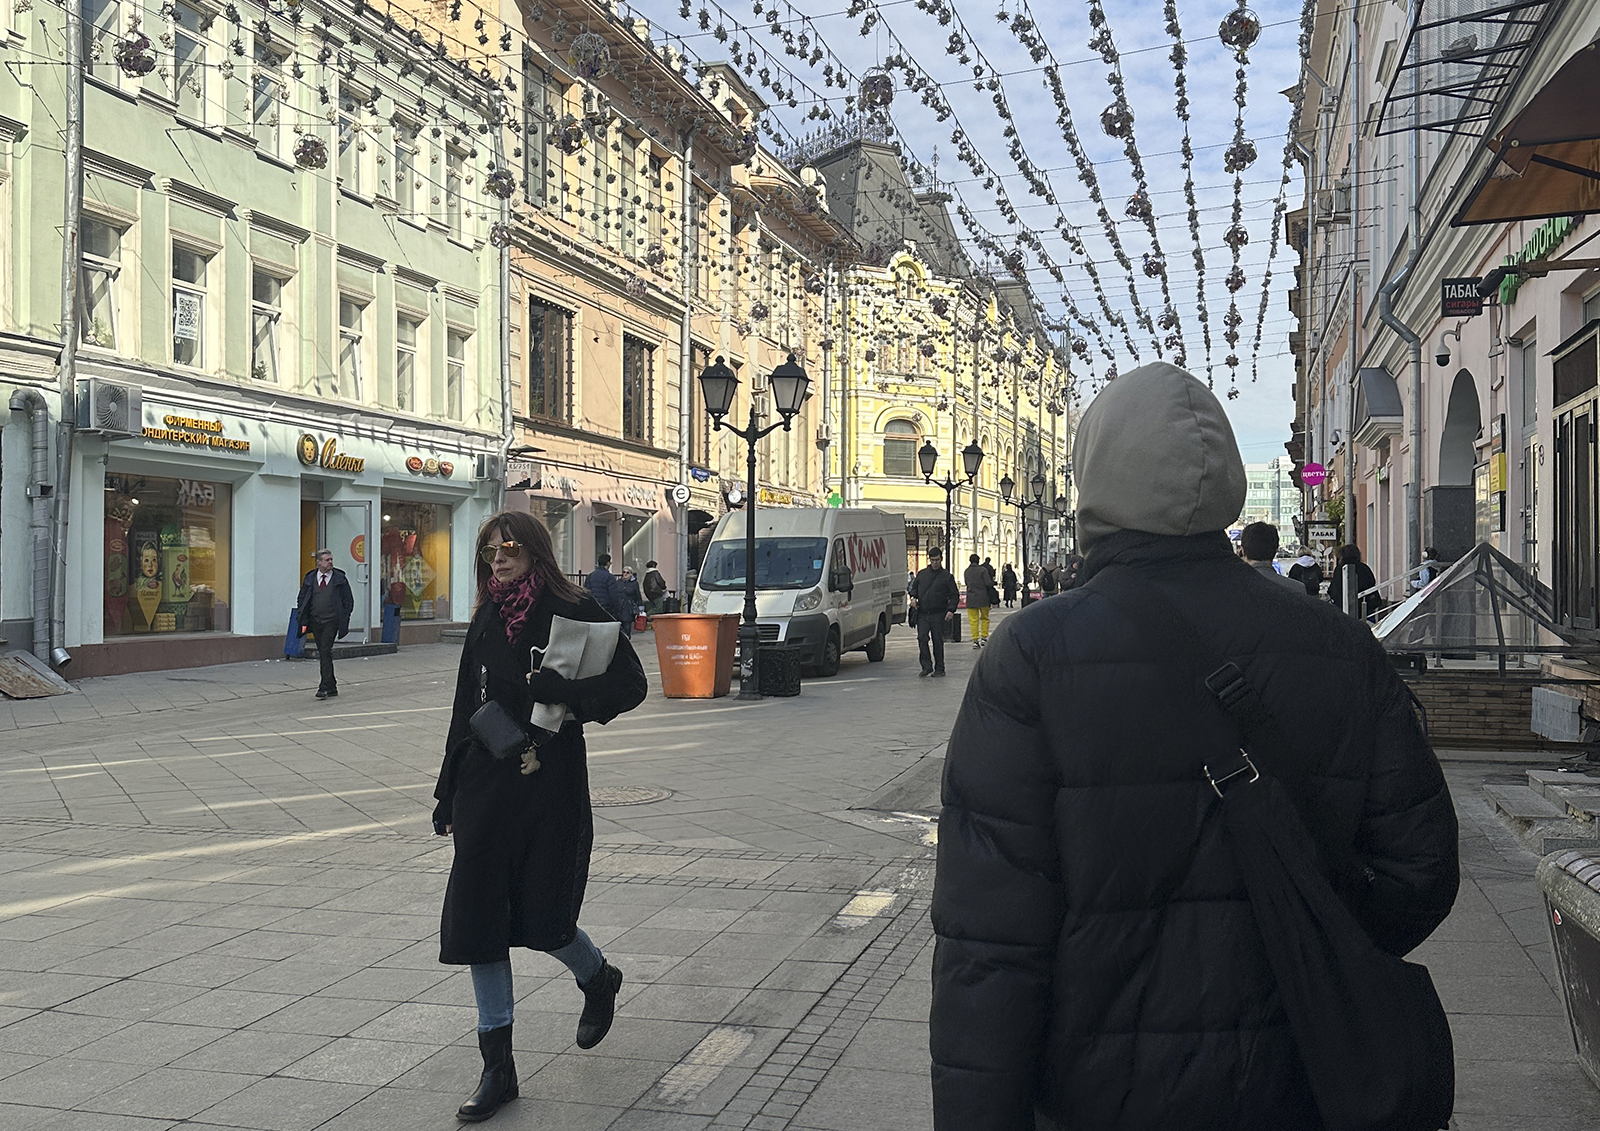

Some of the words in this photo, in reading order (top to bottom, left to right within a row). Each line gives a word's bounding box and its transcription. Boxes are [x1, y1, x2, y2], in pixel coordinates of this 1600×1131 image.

[1444, 284, 1480, 298] ТАБАК
[165, 415, 224, 433] ФИРМЕННЫЙ
[142, 427, 209, 445] ОНДИТЕРСКИЙ
[211, 436, 251, 451] МАГАЗИН
